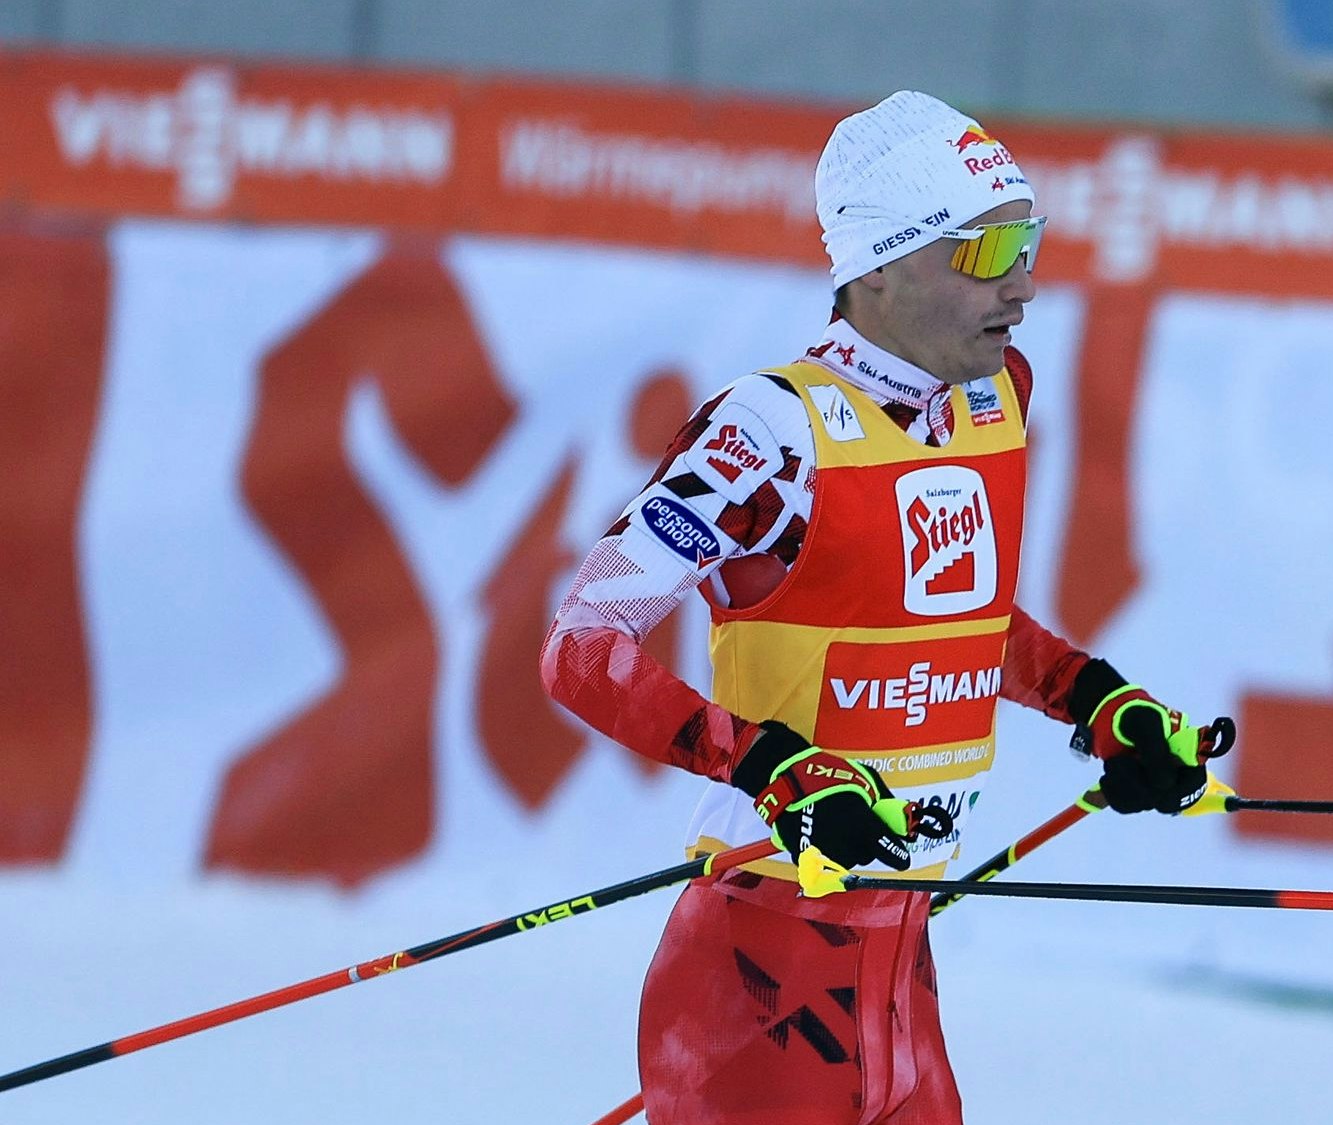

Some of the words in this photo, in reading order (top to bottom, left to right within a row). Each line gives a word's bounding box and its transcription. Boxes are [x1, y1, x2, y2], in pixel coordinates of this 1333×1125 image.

[503, 115, 816, 222] Wärmepump
[964, 148, 1004, 176] Red
[857, 361, 877, 378] Ski
[878, 374, 921, 399] Austria
[703, 424, 768, 471] Stiegl
[926, 487, 962, 498] Salzburger
[646, 498, 717, 551] personal
[654, 518, 694, 549] shop
[906, 490, 984, 578] Stiegl
[830, 661, 1001, 727] VIESSMANN
[806, 763, 871, 792] LEKI
[898, 751, 951, 772] COMBINED
[517, 895, 599, 933] LEKI
